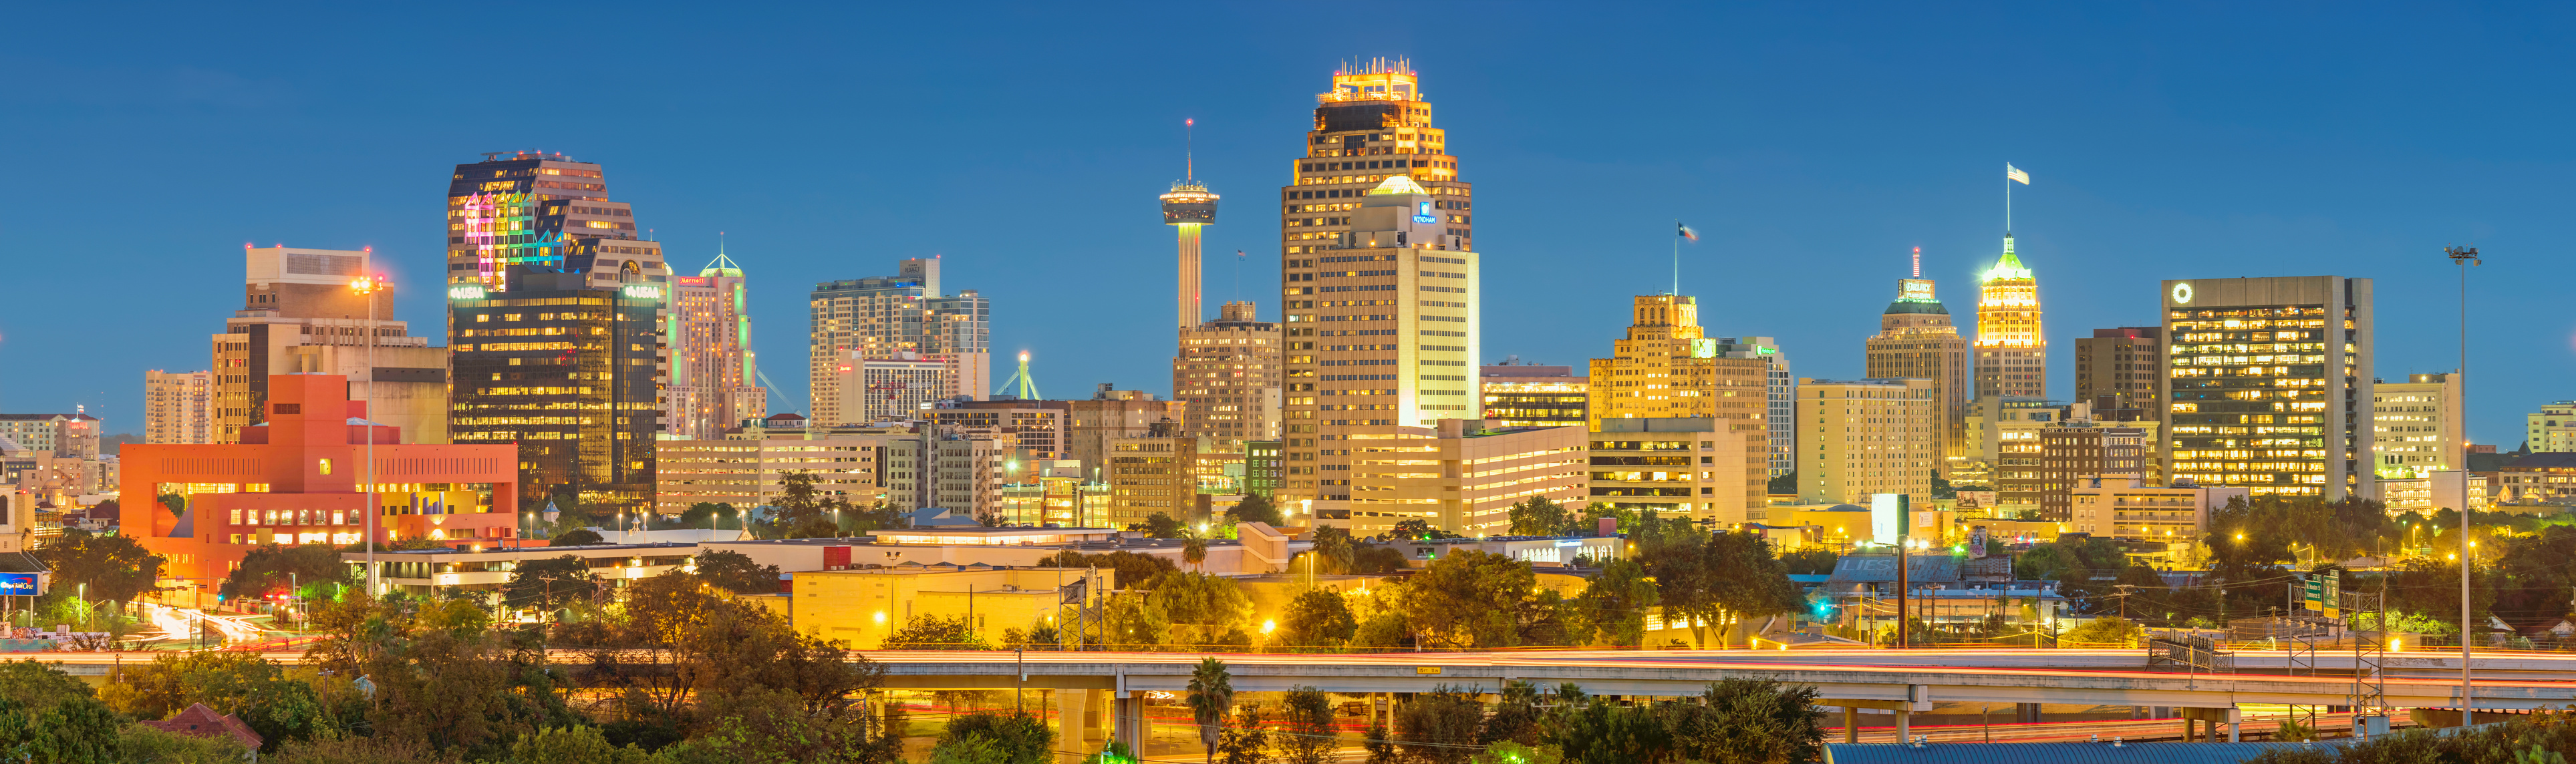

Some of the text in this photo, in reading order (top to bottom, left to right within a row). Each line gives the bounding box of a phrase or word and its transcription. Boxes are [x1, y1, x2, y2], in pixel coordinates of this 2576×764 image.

[1413, 216, 1435, 224] WYNDHAM
[461, 286, 484, 299] USAA
[636, 286, 659, 299] USAA
